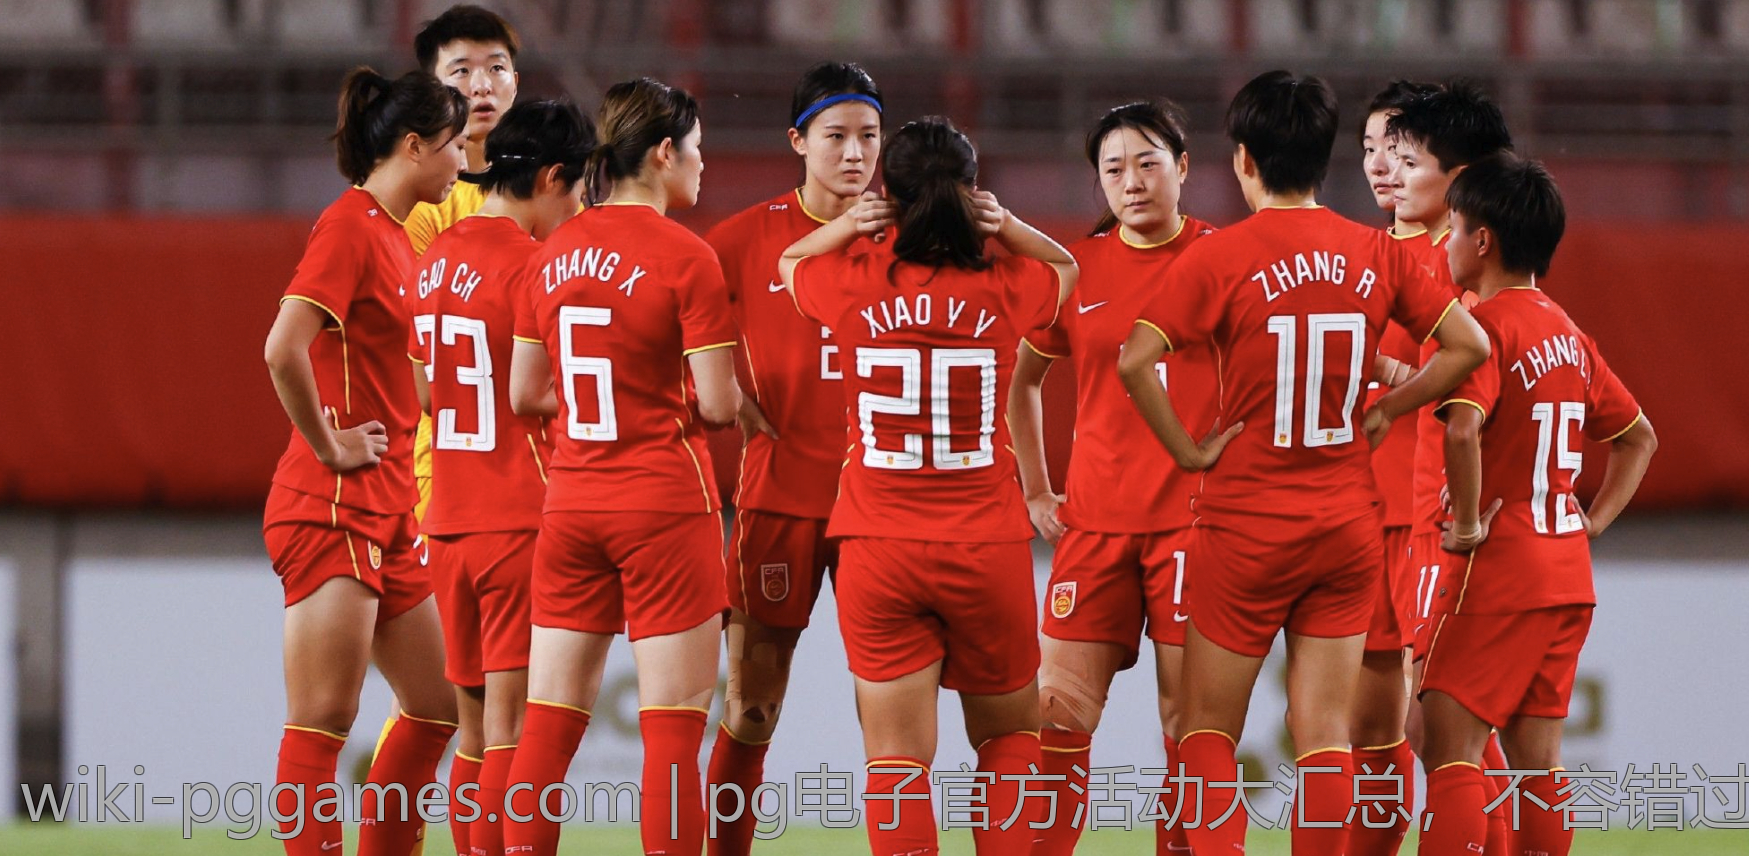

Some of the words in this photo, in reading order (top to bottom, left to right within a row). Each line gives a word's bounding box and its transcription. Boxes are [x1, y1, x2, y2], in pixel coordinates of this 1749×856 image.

[418, 257, 447, 299] GAO
[450, 263, 482, 302] CH
[542, 247, 621, 294] ZHANG
[618, 265, 647, 297] X
[1251, 251, 1346, 302] ZHANG
[1355, 268, 1377, 299] R
[860, 293, 931, 338] XIAO
[948, 297, 966, 328] Y
[973, 309, 997, 338] Y
[558, 305, 619, 441] 6
[1267, 313, 1366, 448] 10
[1510, 334, 1579, 391] ZHANG
[855, 347, 997, 470] 20
[1531, 401, 1586, 534] 15
[1416, 564, 1440, 618] 11
